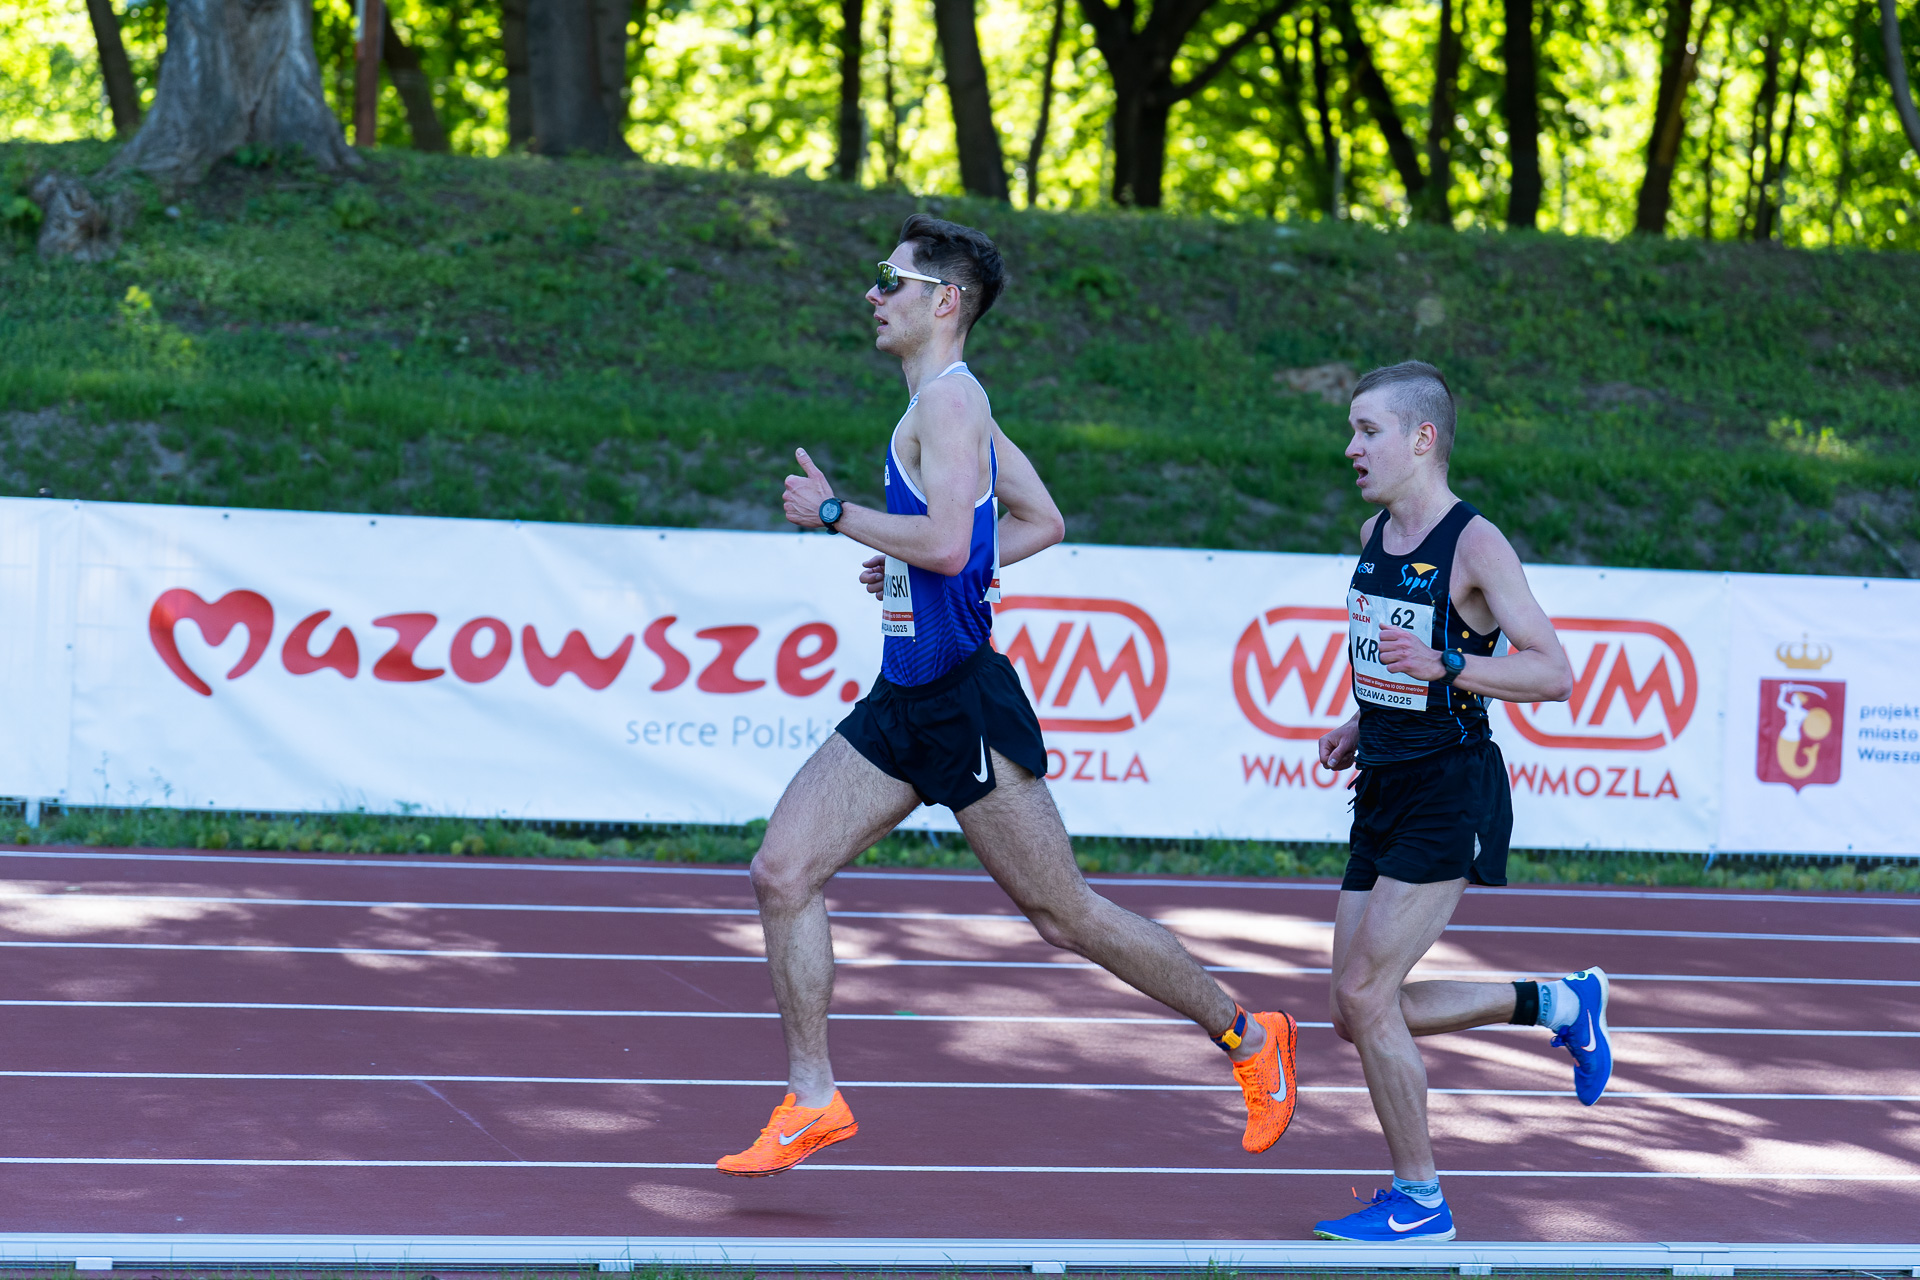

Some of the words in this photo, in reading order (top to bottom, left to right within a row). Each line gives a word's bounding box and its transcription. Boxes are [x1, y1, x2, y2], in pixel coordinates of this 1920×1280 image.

[1397, 563, 1439, 595] Sopot
[893, 624, 908, 633] 2025
[1352, 612, 1371, 624] ORLEN
[1390, 607, 1415, 630] 62
[148, 587, 860, 703] Mazowsze.
[1387, 694, 1412, 705] 2025
[1859, 703, 1920, 722] projekt
[625, 719, 718, 747] serce
[1858, 725, 1919, 742] miasto
[1045, 748, 1149, 783] OZLA
[1241, 753, 1358, 790] WMO
[1508, 762, 1680, 800] WMOZLA
